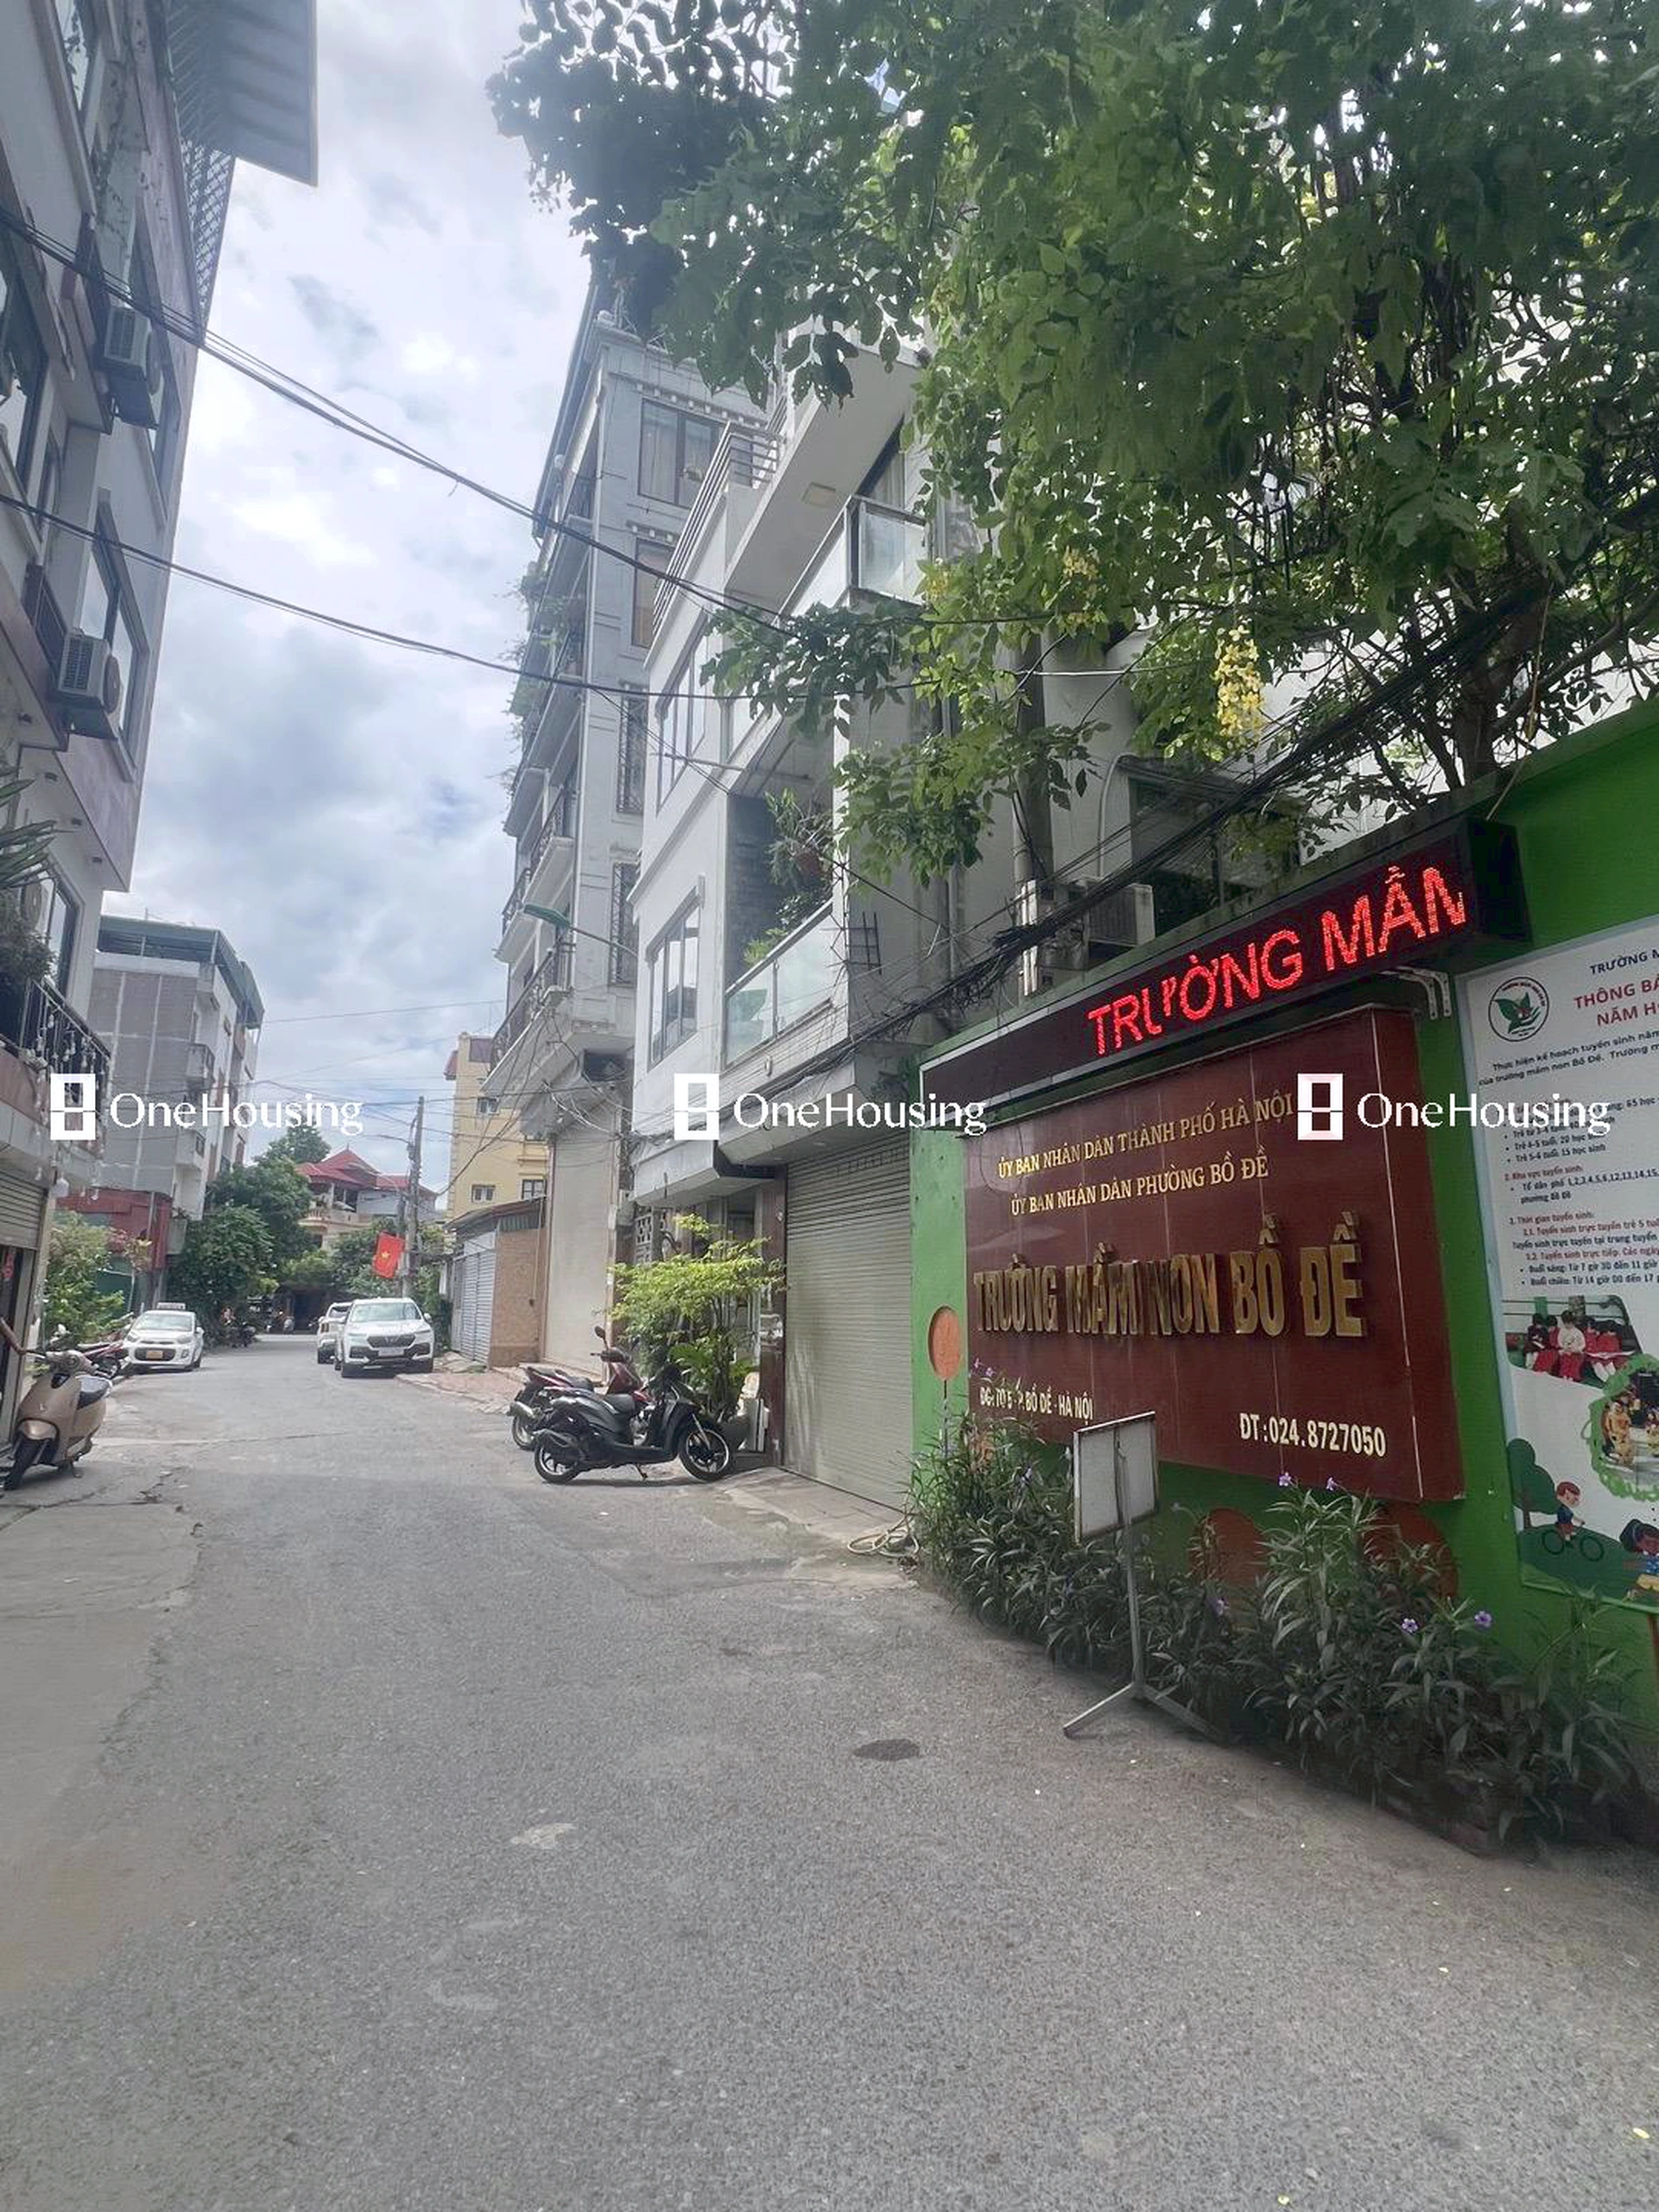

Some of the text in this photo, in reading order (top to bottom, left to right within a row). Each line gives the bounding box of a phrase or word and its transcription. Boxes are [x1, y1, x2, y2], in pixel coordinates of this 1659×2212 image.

[1590, 951, 1648, 974] TRƯỜNG
[1087, 929, 1303, 1055] TRƯỜNG
[1574, 984, 1636, 1009] THÔNG
[1597, 1006, 1638, 1026] NĂM
[1613, 1035, 1636, 1046] sinh
[1552, 1062, 1571, 1071] non
[998, 1089, 1295, 1179] ỦY BAN NHÂN DÂN THÀNH PHỐ HÀ NỘI
[1012, 1144, 1270, 1216] ỦY BAN NHÂN DÂN PHƯỜNG BỒ ĐỀ
[1144, 1252, 1220, 1336] NON
[1230, 1212, 1287, 1337] BỒ
[1300, 1211, 1367, 1338] ĐỀ
[1058, 1389, 1073, 1418] HÀ
[1074, 1391, 1094, 1426] NỘI
